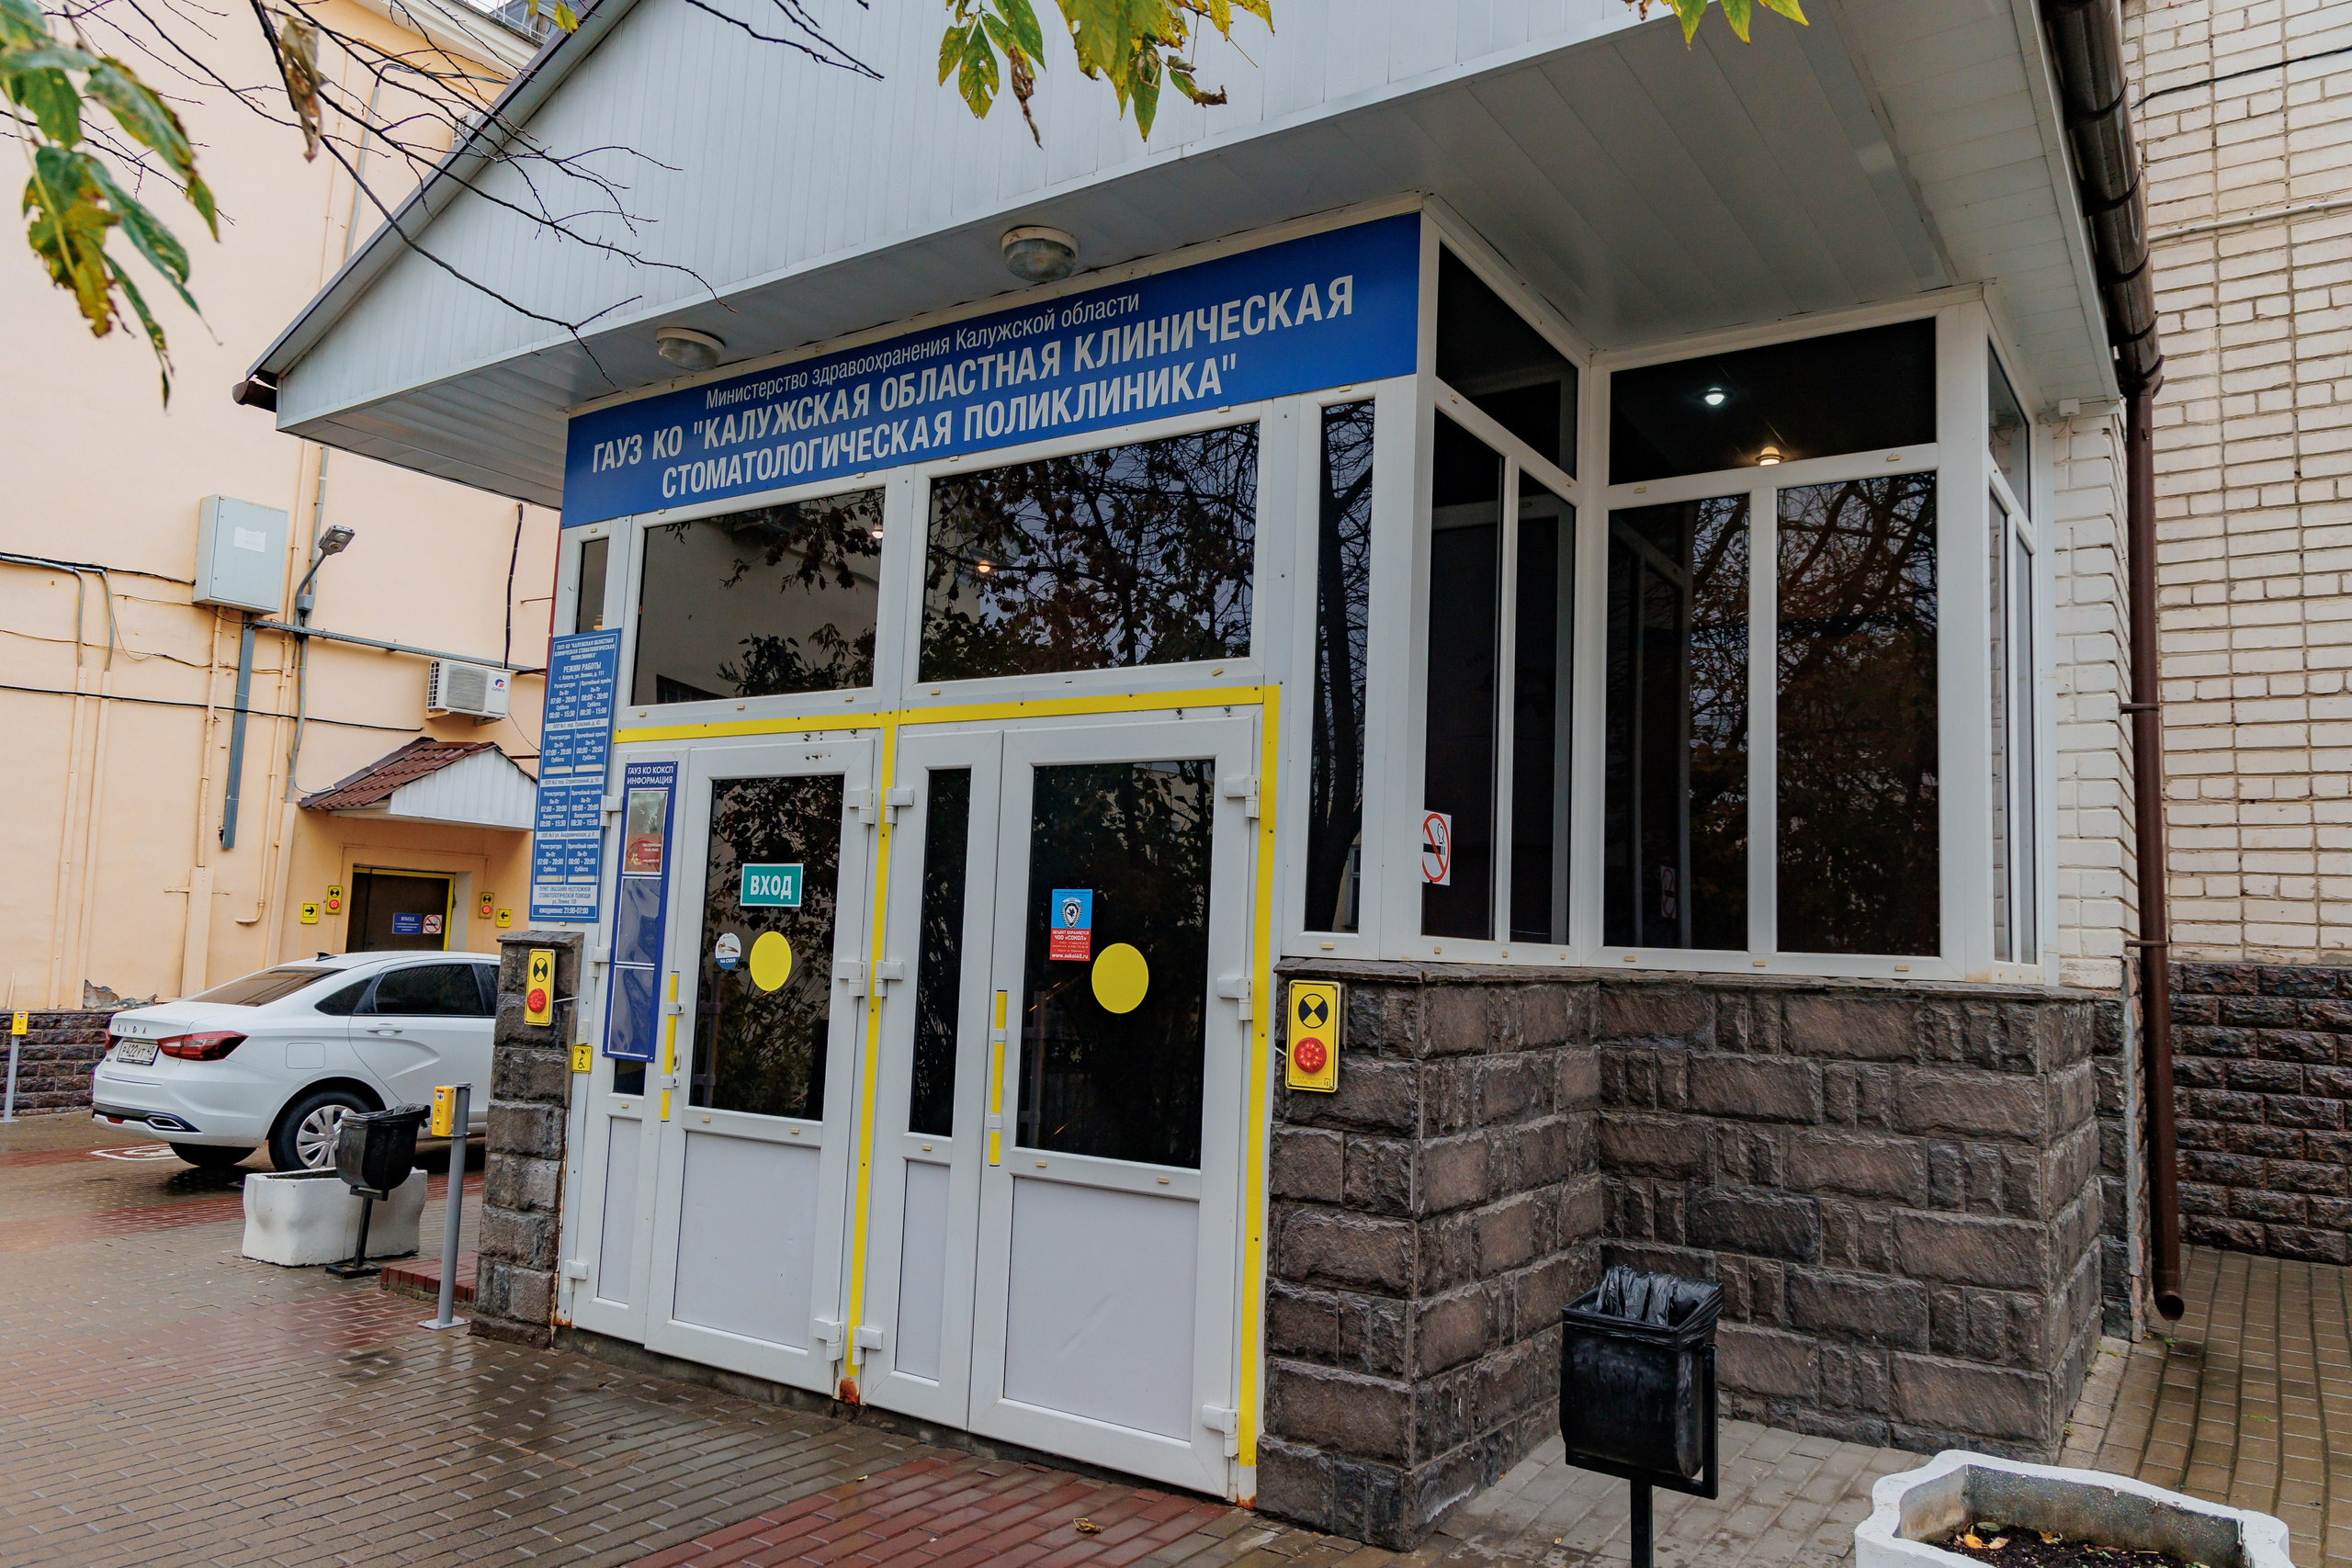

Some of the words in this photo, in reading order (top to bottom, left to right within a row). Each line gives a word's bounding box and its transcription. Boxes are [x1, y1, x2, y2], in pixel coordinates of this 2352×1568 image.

[706, 372, 808, 409] Министерство
[812, 337, 949, 387] здравоохранения
[956, 309, 1055, 351] Калужской
[1061, 293, 1139, 328] области
[593, 434, 642, 473] ГАУЗ
[652, 425, 683, 460] КО
[694, 383, 870, 449] "КАЛУЖСКАЯ
[880, 341, 1061, 412] ОБЛАСТНАЯ
[1074, 275, 1353, 372] КЛИНИЧЕСКАЯ
[662, 411, 952, 499] СТОМАТОЛОГИЧЕСКАЯ
[964, 353, 1236, 442] ПОЛИКЛИНИКА"
[563, 664, 581, 673] РЕЖИМ
[582, 661, 602, 671] РАБОТЫ
[628, 766, 641, 774] ГАУЗ
[642, 766, 651, 774] КО
[652, 765, 673, 774] КОКСП
[627, 776, 673, 785] ИНФОРМАЦИЯ
[750, 874, 792, 899] ВХОД
[118, 1024, 146, 1033] LADA
